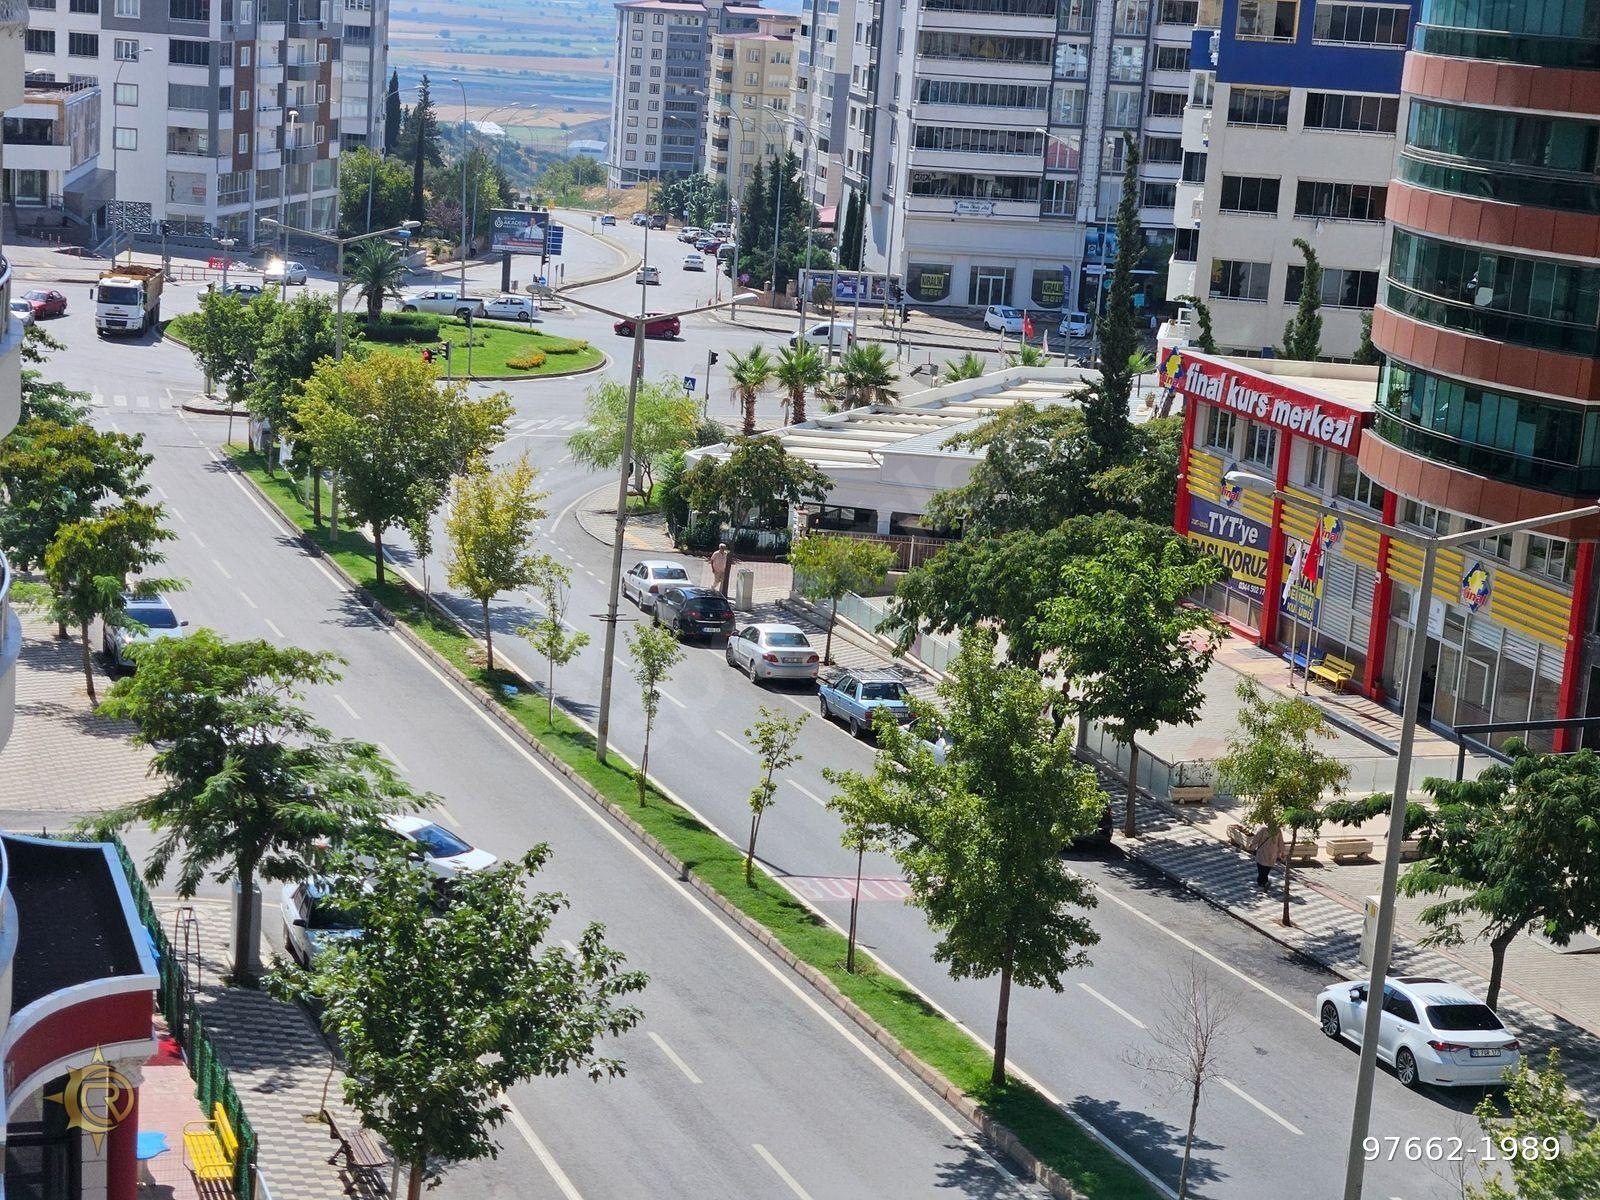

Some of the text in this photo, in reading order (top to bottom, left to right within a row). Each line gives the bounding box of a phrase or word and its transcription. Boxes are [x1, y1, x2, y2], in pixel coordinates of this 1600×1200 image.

[1184, 362, 1356, 449] final kurs merkezi
[1322, 530, 1339, 543] inal
[1286, 601, 1313, 621] KUÜBÜ
